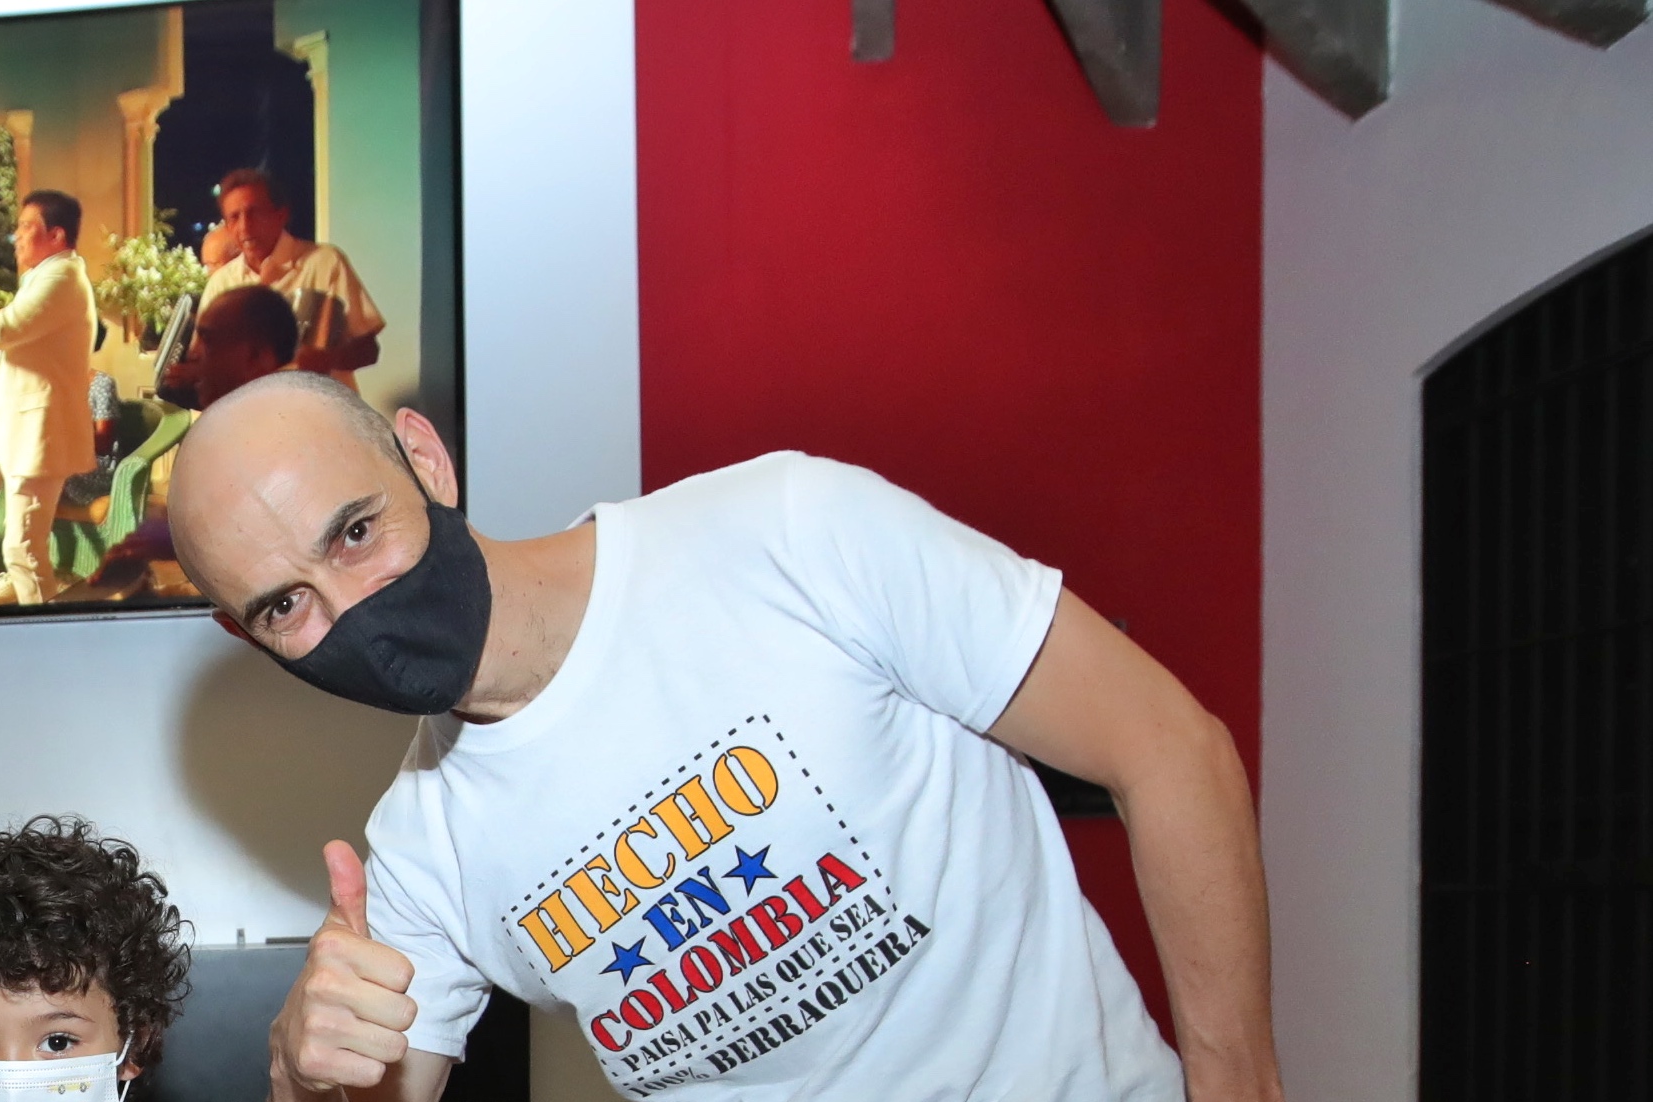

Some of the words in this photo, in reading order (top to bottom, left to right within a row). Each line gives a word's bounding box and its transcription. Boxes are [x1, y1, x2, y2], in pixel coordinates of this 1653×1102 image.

[517, 745, 779, 973] HECHO
[642, 865, 732, 953] EN
[590, 851, 867, 1053] COLOMBIA
[620, 1022, 698, 1072] PAISA
[693, 1001, 733, 1036] PA
[727, 972, 777, 1015] LAS
[776, 931, 834, 983] QUE
[829, 894, 887, 943] SEA
[628, 1066, 711, 1098] 100%
[704, 914, 932, 1075] BERRAQUERA
